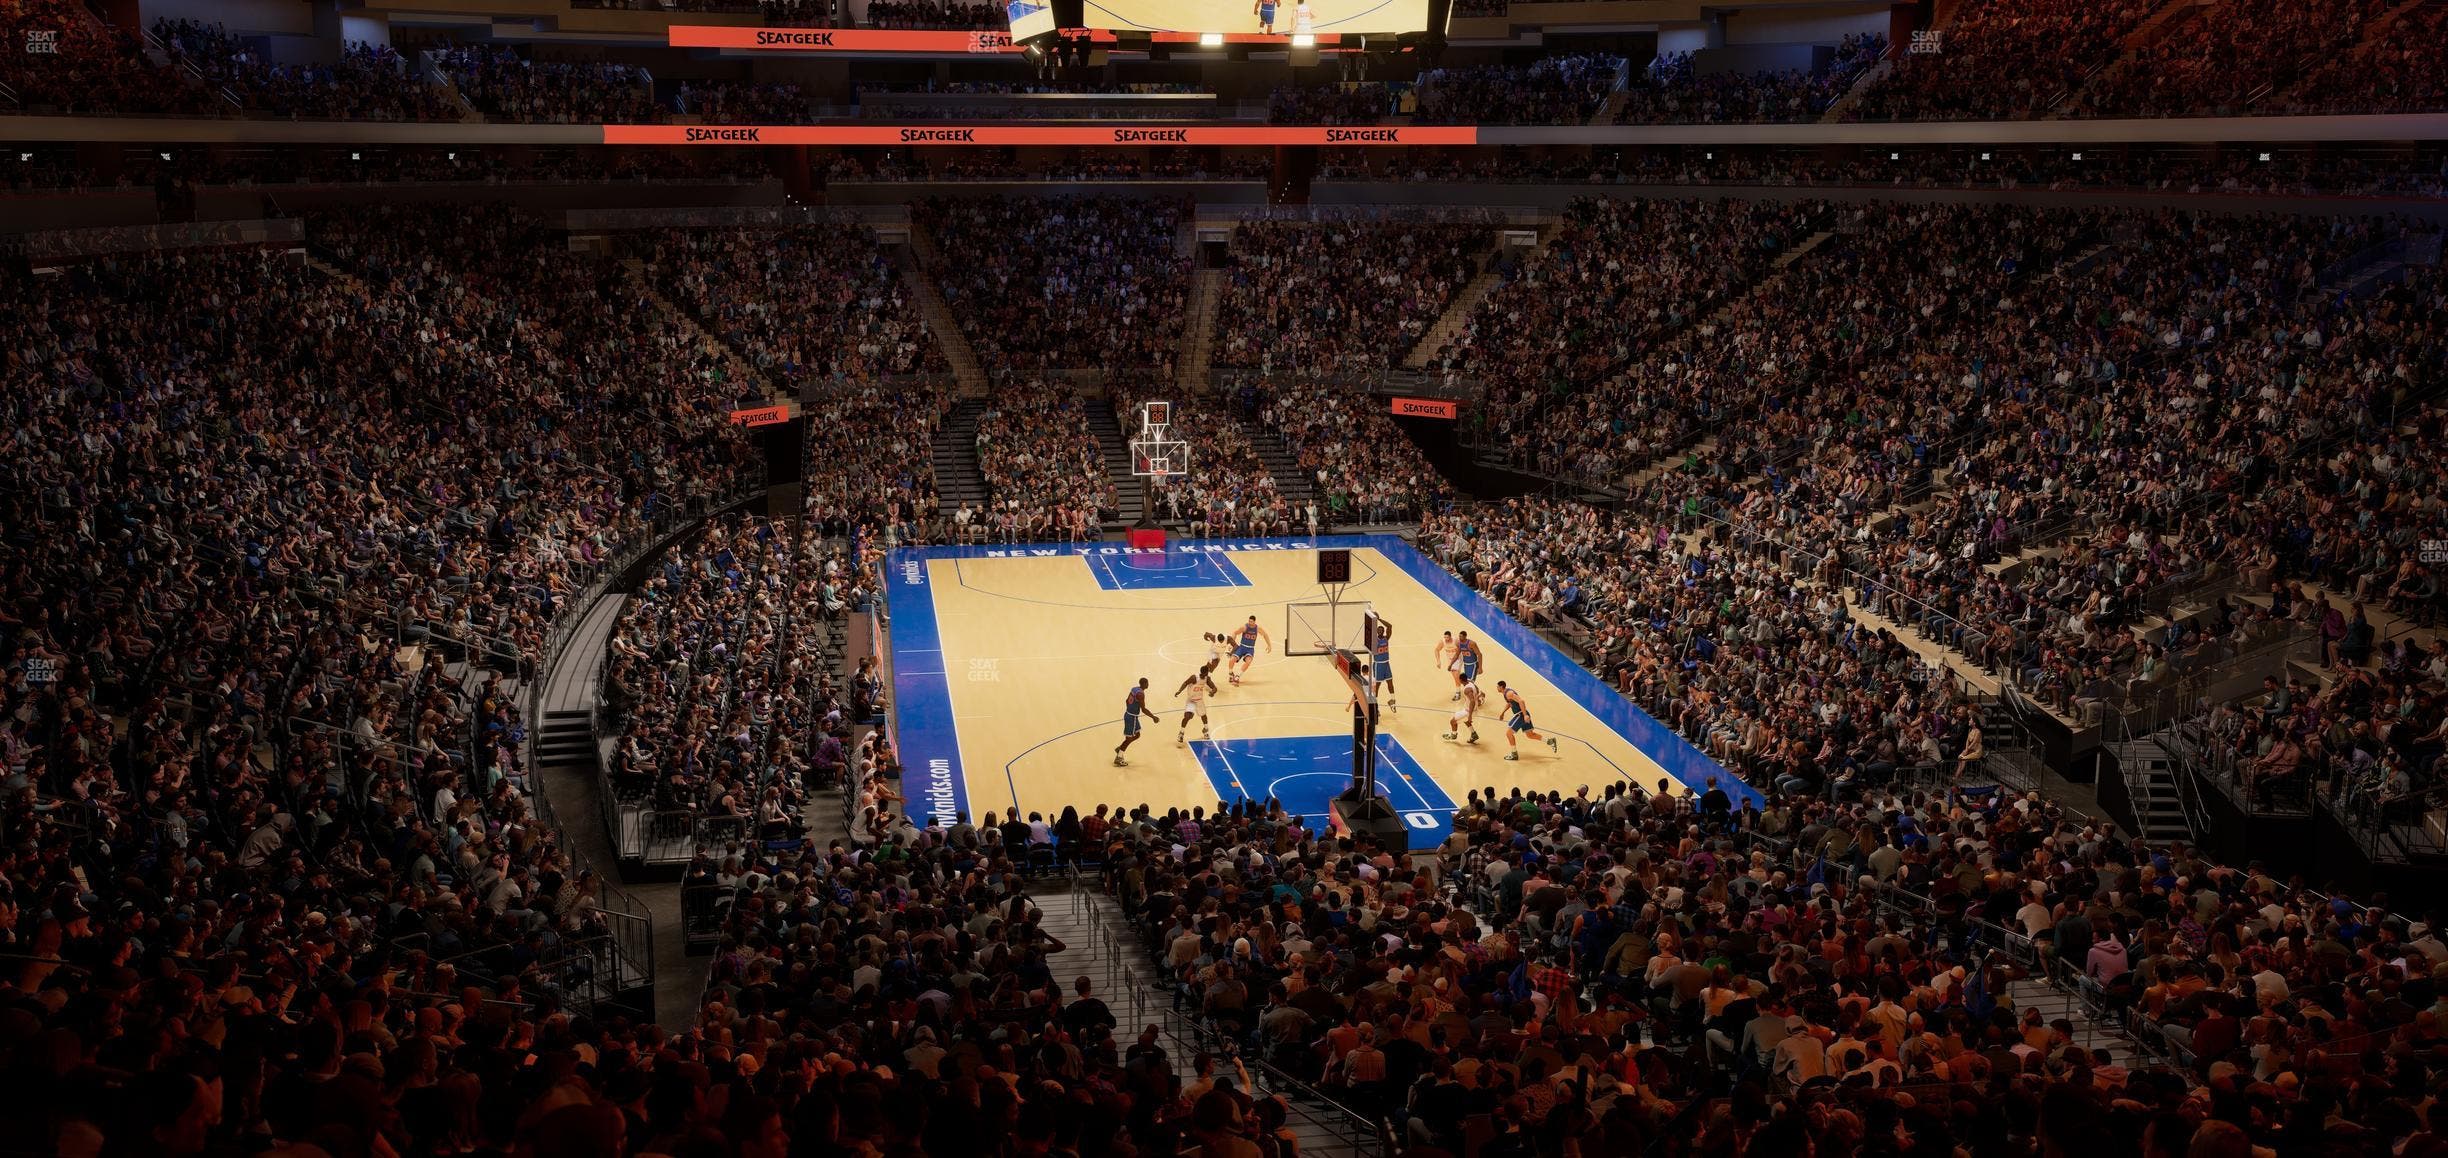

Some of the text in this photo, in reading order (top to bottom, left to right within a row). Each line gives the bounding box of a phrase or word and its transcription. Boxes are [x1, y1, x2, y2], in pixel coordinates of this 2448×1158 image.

[757, 31, 834, 46] SEATGEEK
[686, 128, 760, 142] SEATGEEK
[900, 128, 975, 142] SEATGEEK
[1114, 128, 1188, 142] SEATGEEK
[1326, 128, 1399, 142] SEATGEEK
[1403, 403, 1446, 416] SEATGEEK
[741, 411, 779, 424] SEATGEEK
[987, 542, 1311, 558] NEW YORK KNICKS
